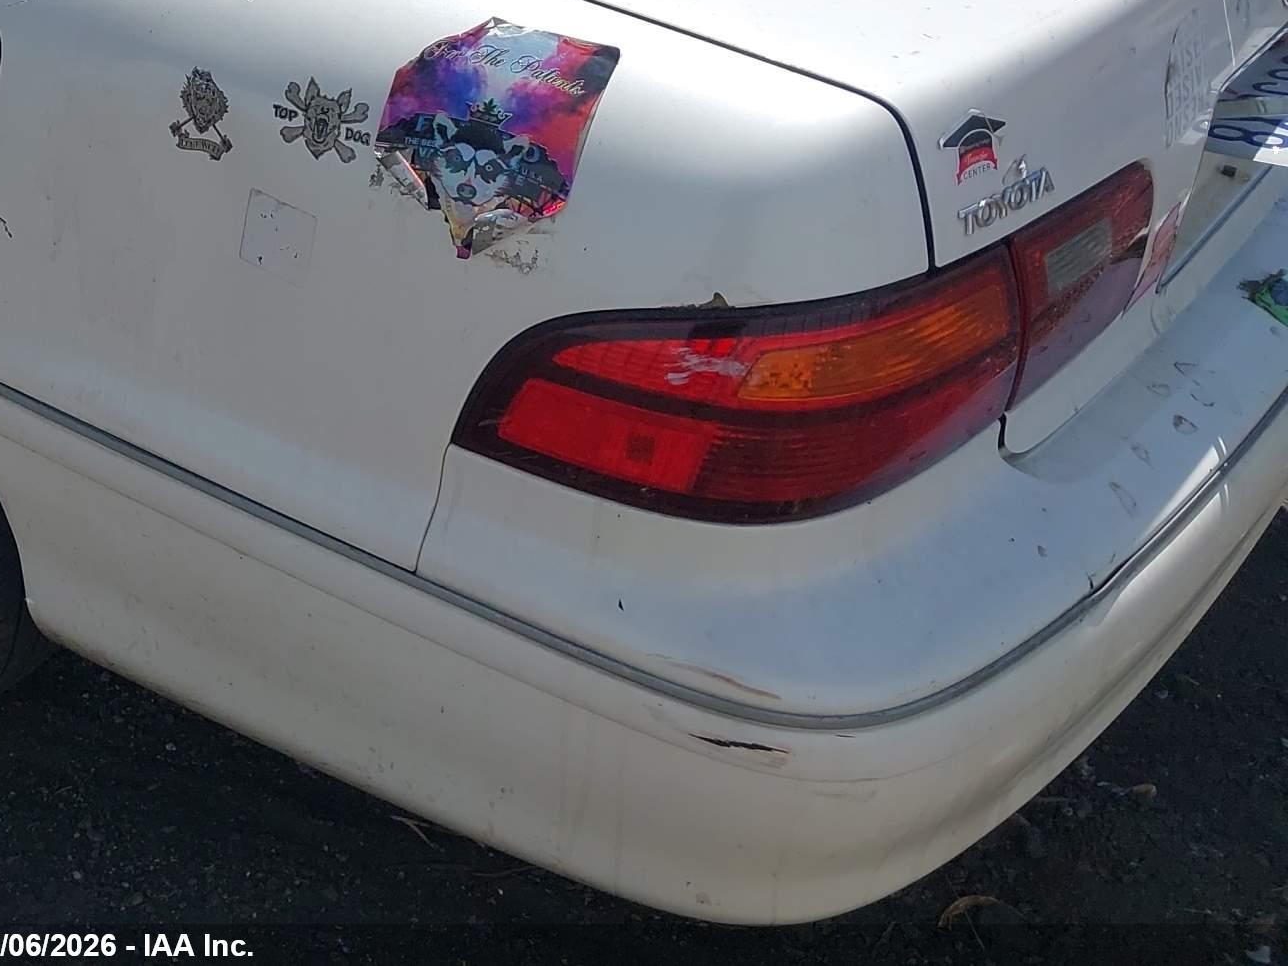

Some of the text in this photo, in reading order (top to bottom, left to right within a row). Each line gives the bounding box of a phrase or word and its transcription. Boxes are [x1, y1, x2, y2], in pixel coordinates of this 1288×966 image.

[469, 44, 510, 68] The
[272, 103, 298, 122] TOP
[344, 127, 372, 146] DOG
[963, 162, 991, 180] CENTER
[958, 166, 1056, 236] TOYOTA
